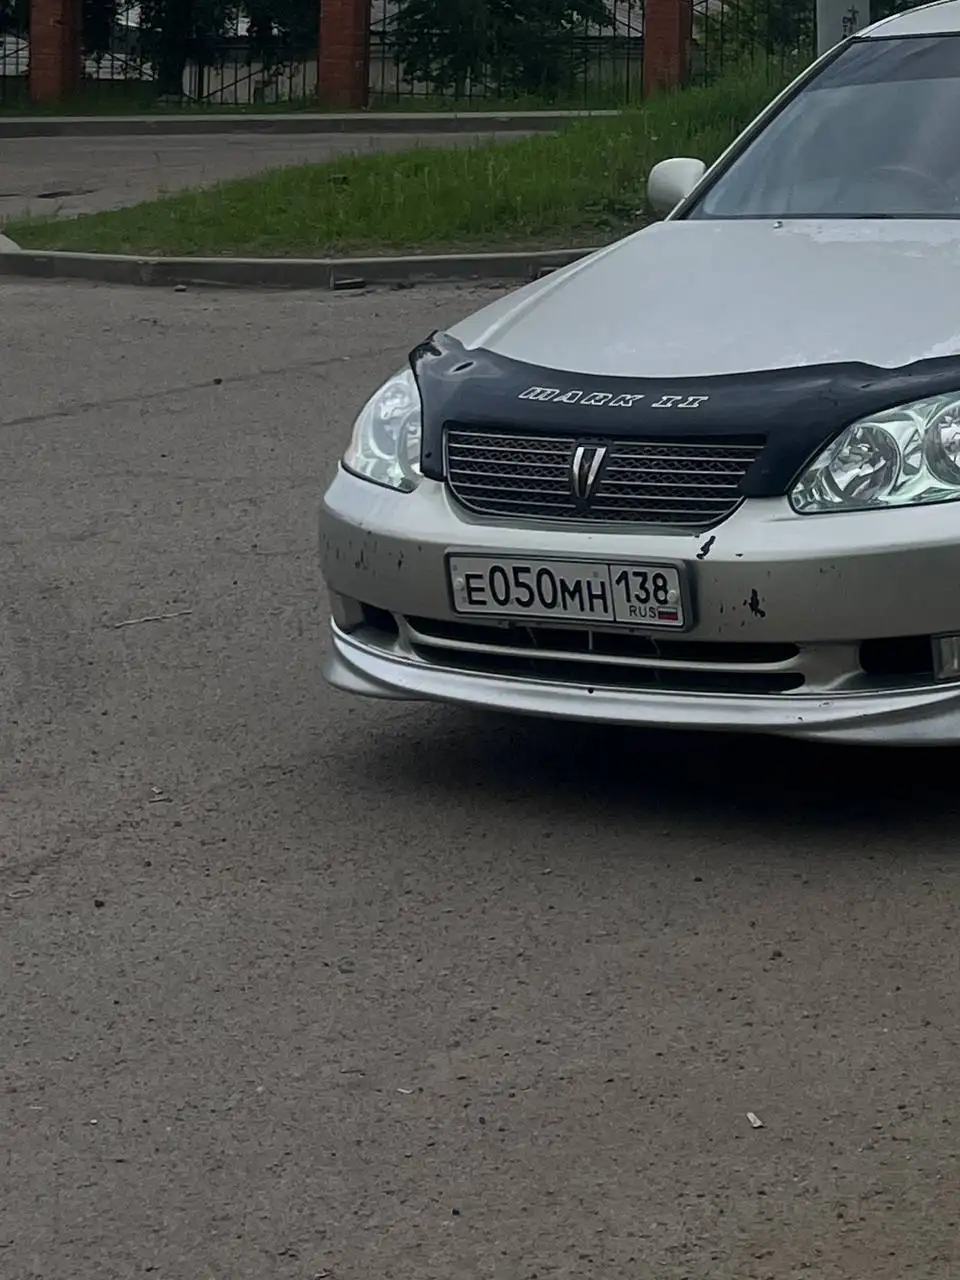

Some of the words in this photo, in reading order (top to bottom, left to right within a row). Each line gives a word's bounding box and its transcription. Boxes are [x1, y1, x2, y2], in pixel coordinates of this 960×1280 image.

[518, 386, 645, 407] MARK
[651, 395, 709, 408] II
[615, 570, 669, 605] 138
[629, 605, 657, 618] RUS
